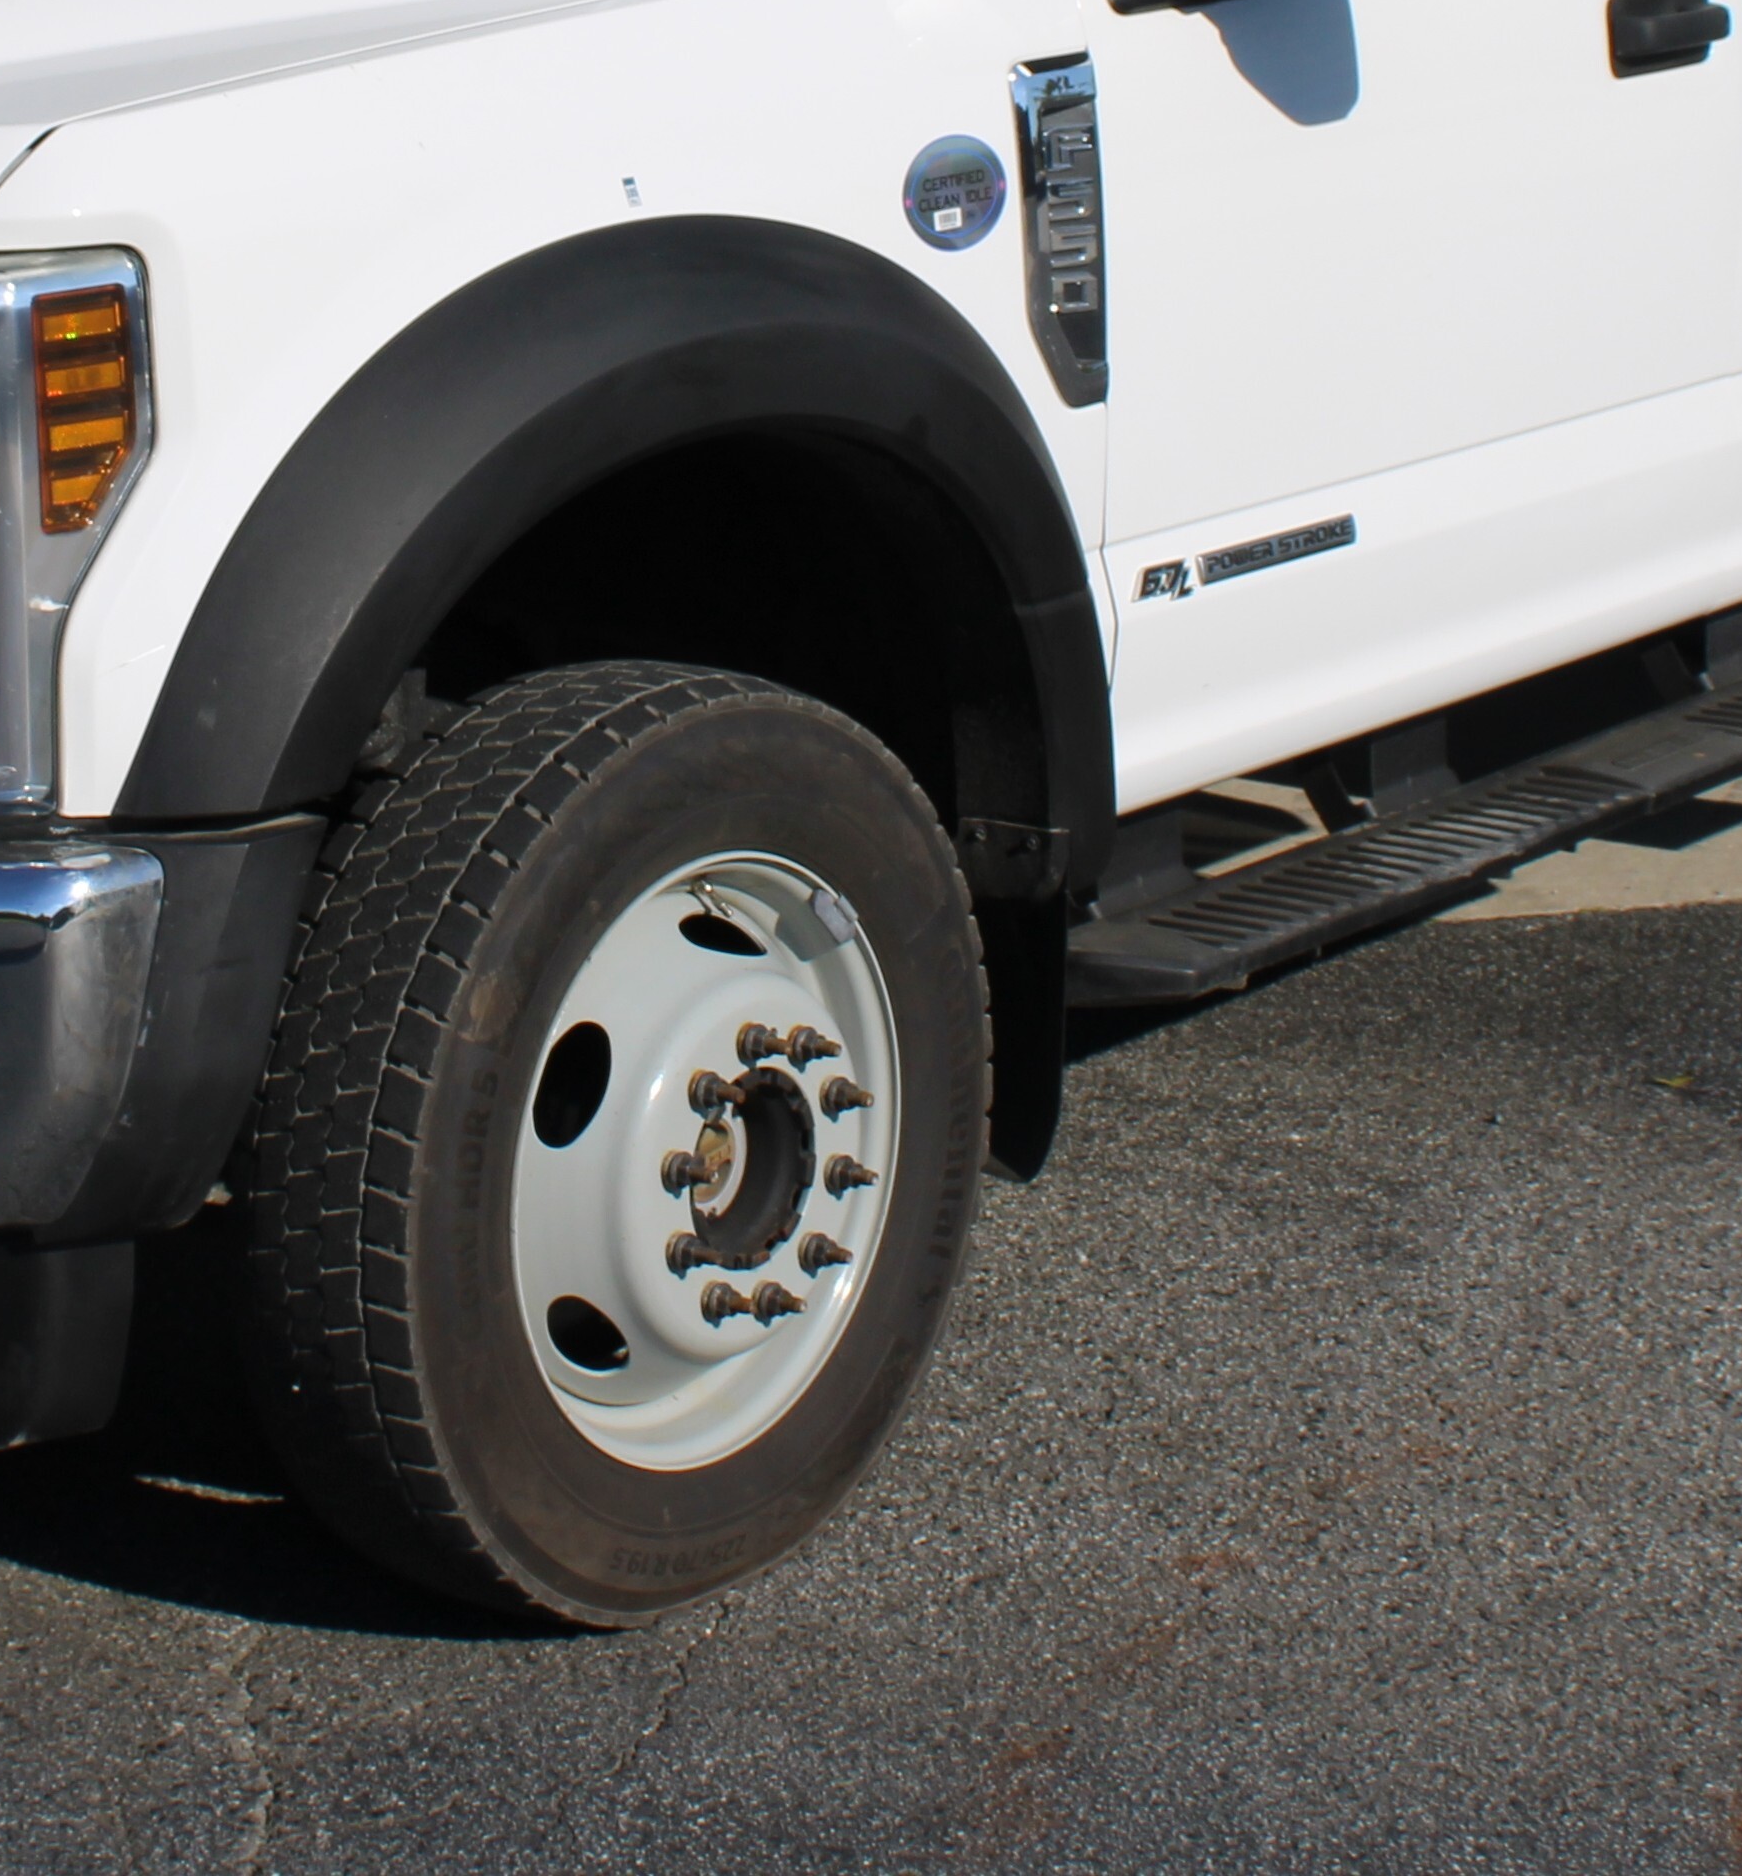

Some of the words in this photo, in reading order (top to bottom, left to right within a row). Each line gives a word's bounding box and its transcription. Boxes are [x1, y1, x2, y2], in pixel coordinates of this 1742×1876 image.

[922, 169, 985, 192] CERTIFIED
[918, 193, 960, 213] CLEAN
[965, 186, 993, 204] IDLE
[1207, 541, 1274, 573] POWER
[1279, 518, 1353, 554] STROKE
